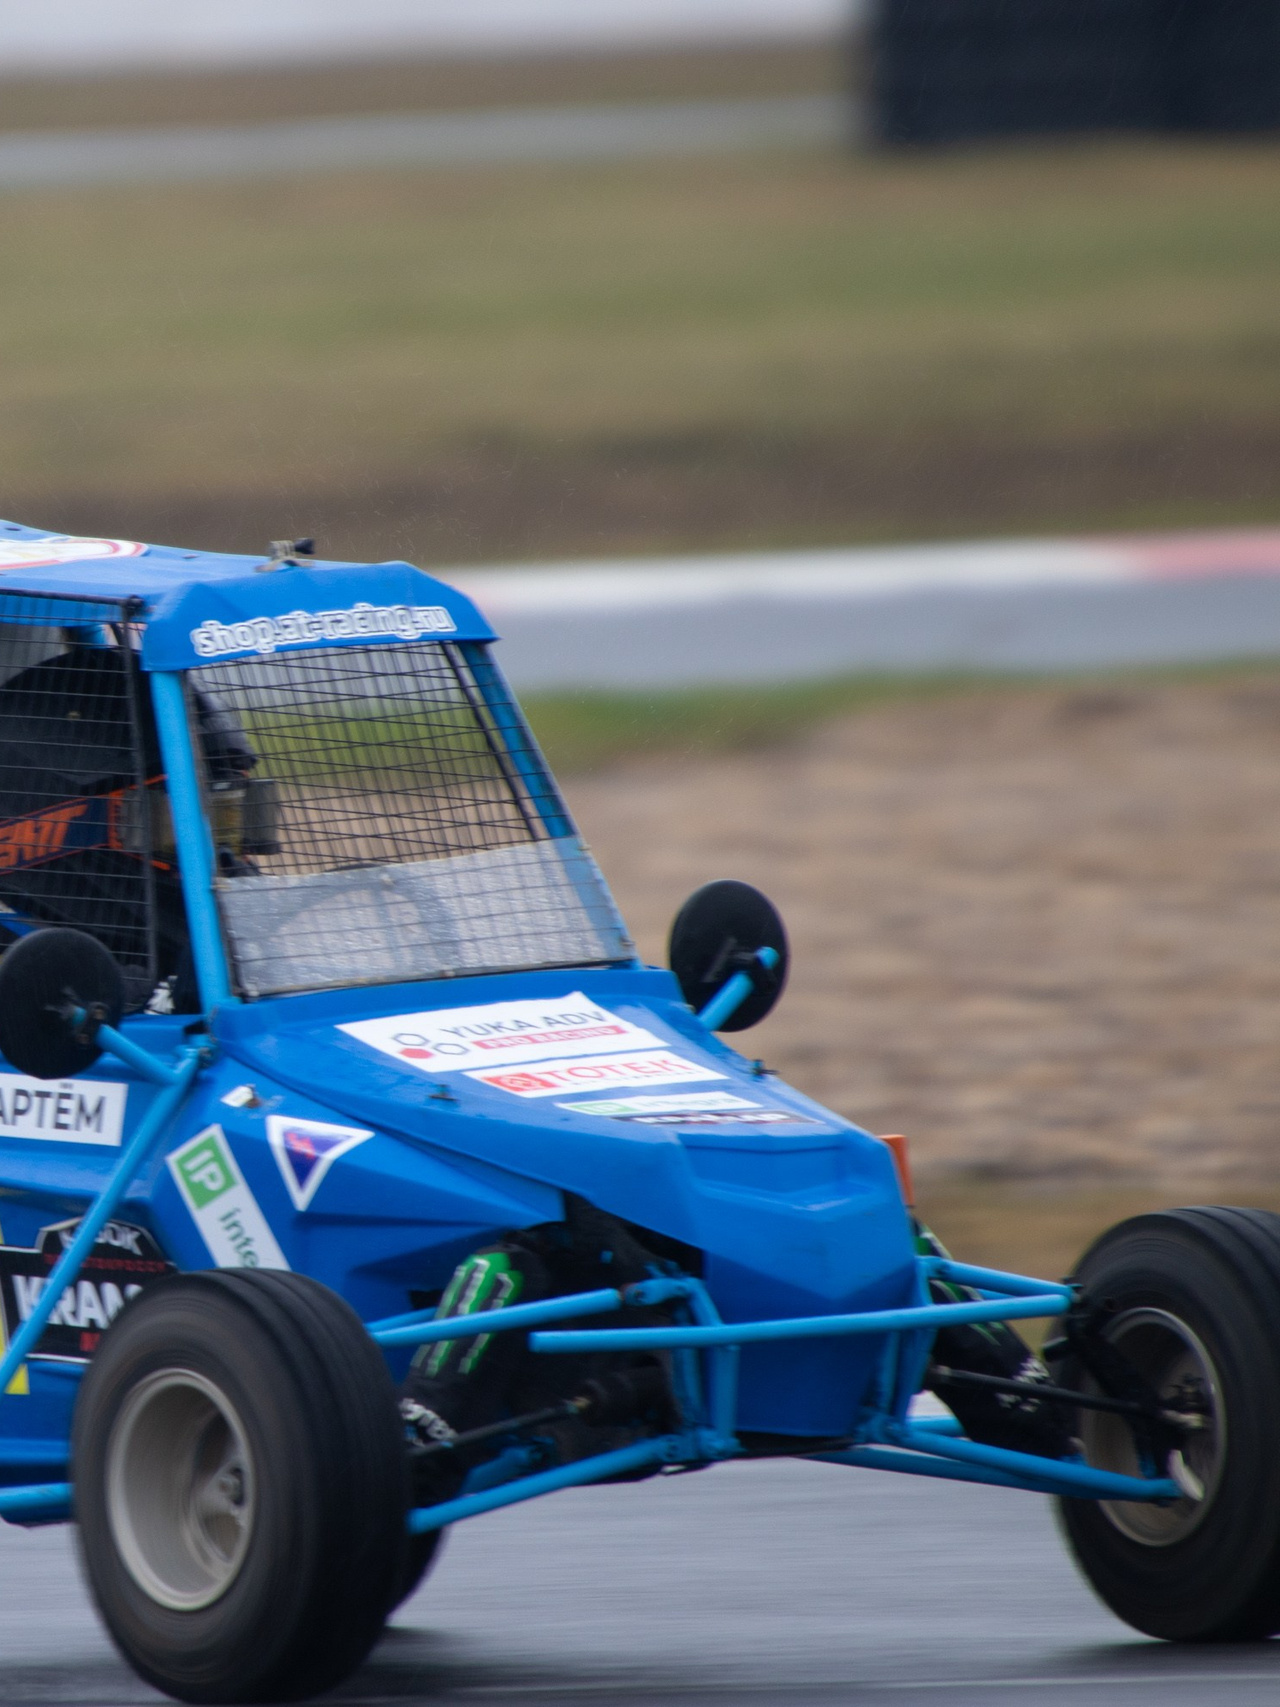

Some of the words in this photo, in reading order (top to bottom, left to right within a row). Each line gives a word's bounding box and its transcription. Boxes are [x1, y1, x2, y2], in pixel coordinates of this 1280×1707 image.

[439, 1019, 540, 1038] YUKA
[541, 1011, 608, 1028] ADV
[535, 1059, 694, 1082] TOTEK
[182, 1148, 227, 1191] IP
[219, 1207, 260, 1268] inte
